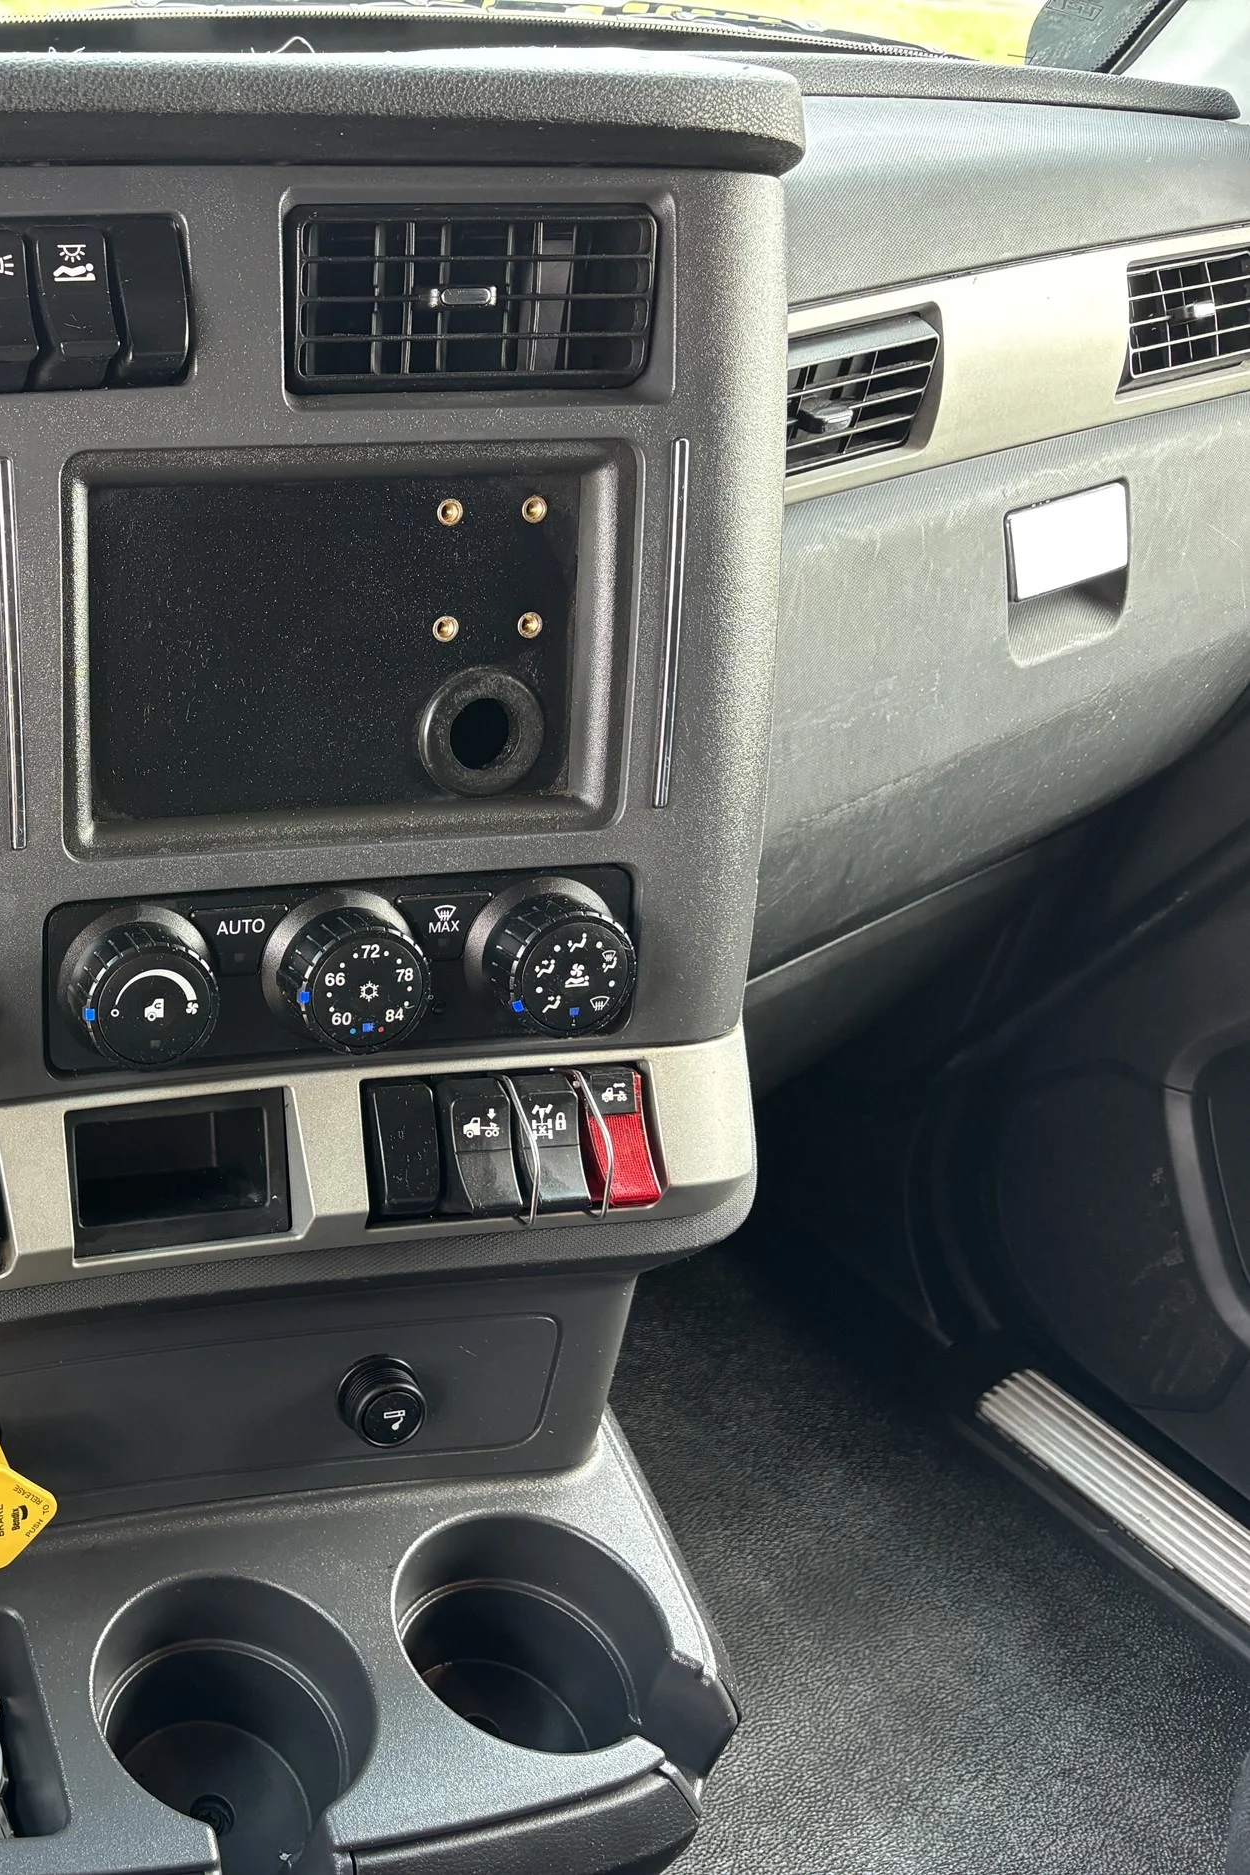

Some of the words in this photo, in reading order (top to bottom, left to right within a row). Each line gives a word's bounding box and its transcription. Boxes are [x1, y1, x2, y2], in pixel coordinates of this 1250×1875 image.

[216, 918, 266, 936] AUTO
[428, 919, 460, 934] MAX
[361, 944, 380, 959] 72
[324, 973, 346, 987] 66
[395, 967, 414, 982] 78
[331, 1013, 352, 1026] 60
[385, 1009, 404, 1022] 84
[13, 1484, 43, 1506] RELEASE
[42, 1504, 50, 1516] TO
[11, 1507, 21, 1531] Bendix
[25, 1518, 44, 1538] PUSH
